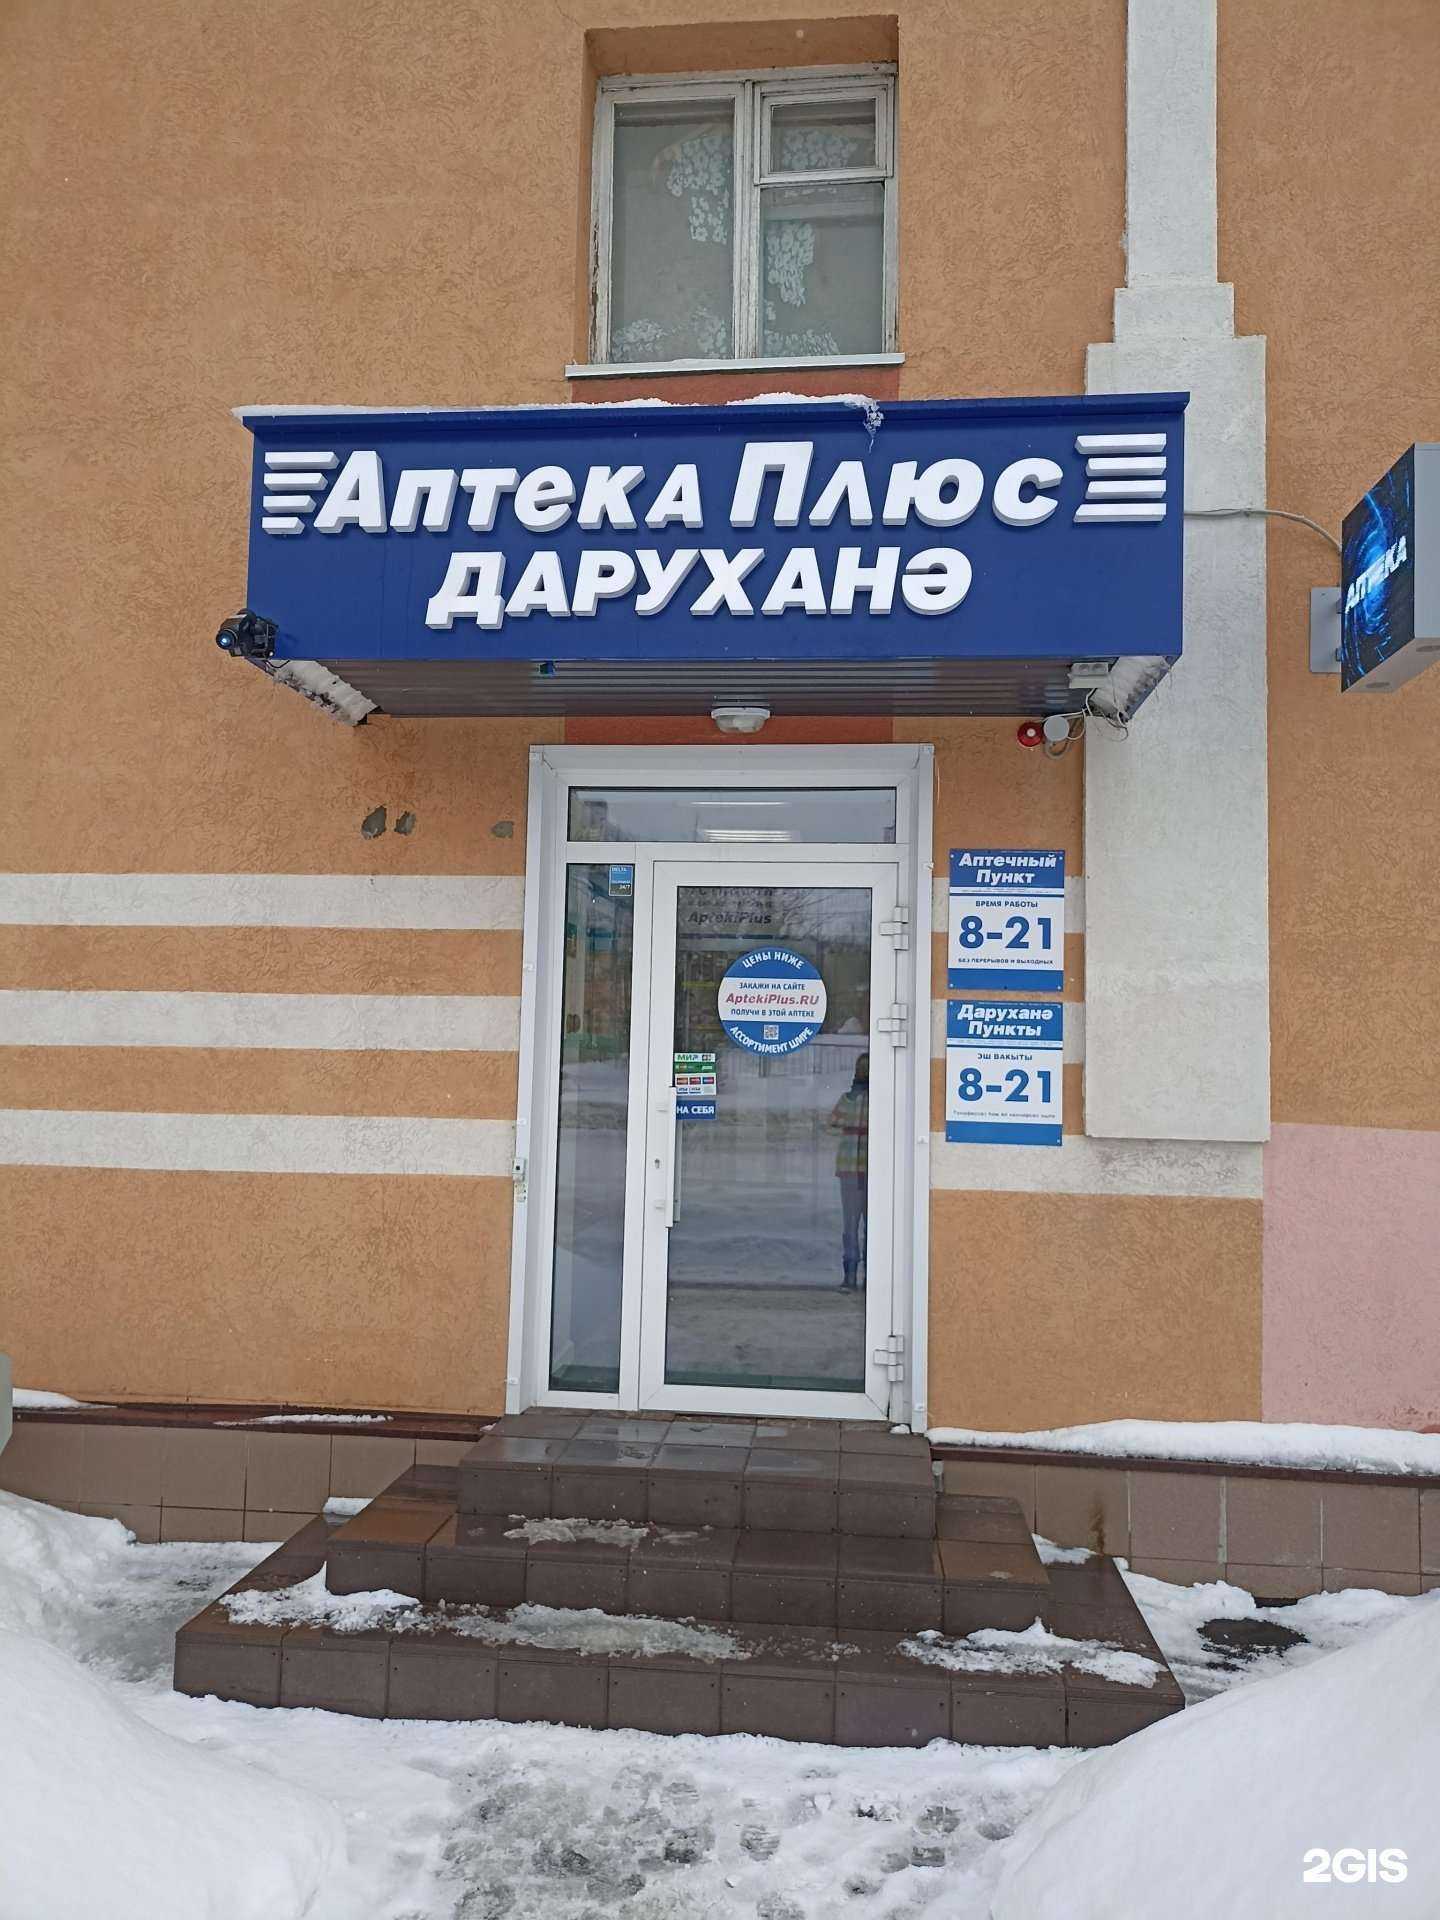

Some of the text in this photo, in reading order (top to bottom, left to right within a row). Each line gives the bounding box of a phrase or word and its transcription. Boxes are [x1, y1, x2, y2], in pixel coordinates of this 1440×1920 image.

[730, 441, 1064, 527] Плюс
[425, 546, 973, 629] ДАРУХАНӘ
[958, 853, 1057, 868] Аптечный
[976, 869, 1035, 886] Пункт
[975, 900, 1039, 908] ВРЕМЯ РАБОТЫ
[959, 915, 1052, 950] 8-21
[742, 951, 805, 970] ЦЕНЫ НИЖЕ
[783, 983, 806, 991] САЙТЕ
[726, 993, 820, 1005] AptekiPlus.RU
[731, 1008, 760, 1016] ПОЛУЧИ
[768, 1008, 786, 1017] ЭТОЙ
[957, 1004, 1054, 1021] Даруханә
[968, 1021, 1042, 1038] Пункты
[729, 1026, 814, 1053] АССОРТИМЕНТ ШИРЕ
[993, 1053, 1033, 1061] ВАКЫТЫ
[958, 1067, 1051, 1103] 8-21
[676, 1105, 715, 1114] НА СЕБЯ
